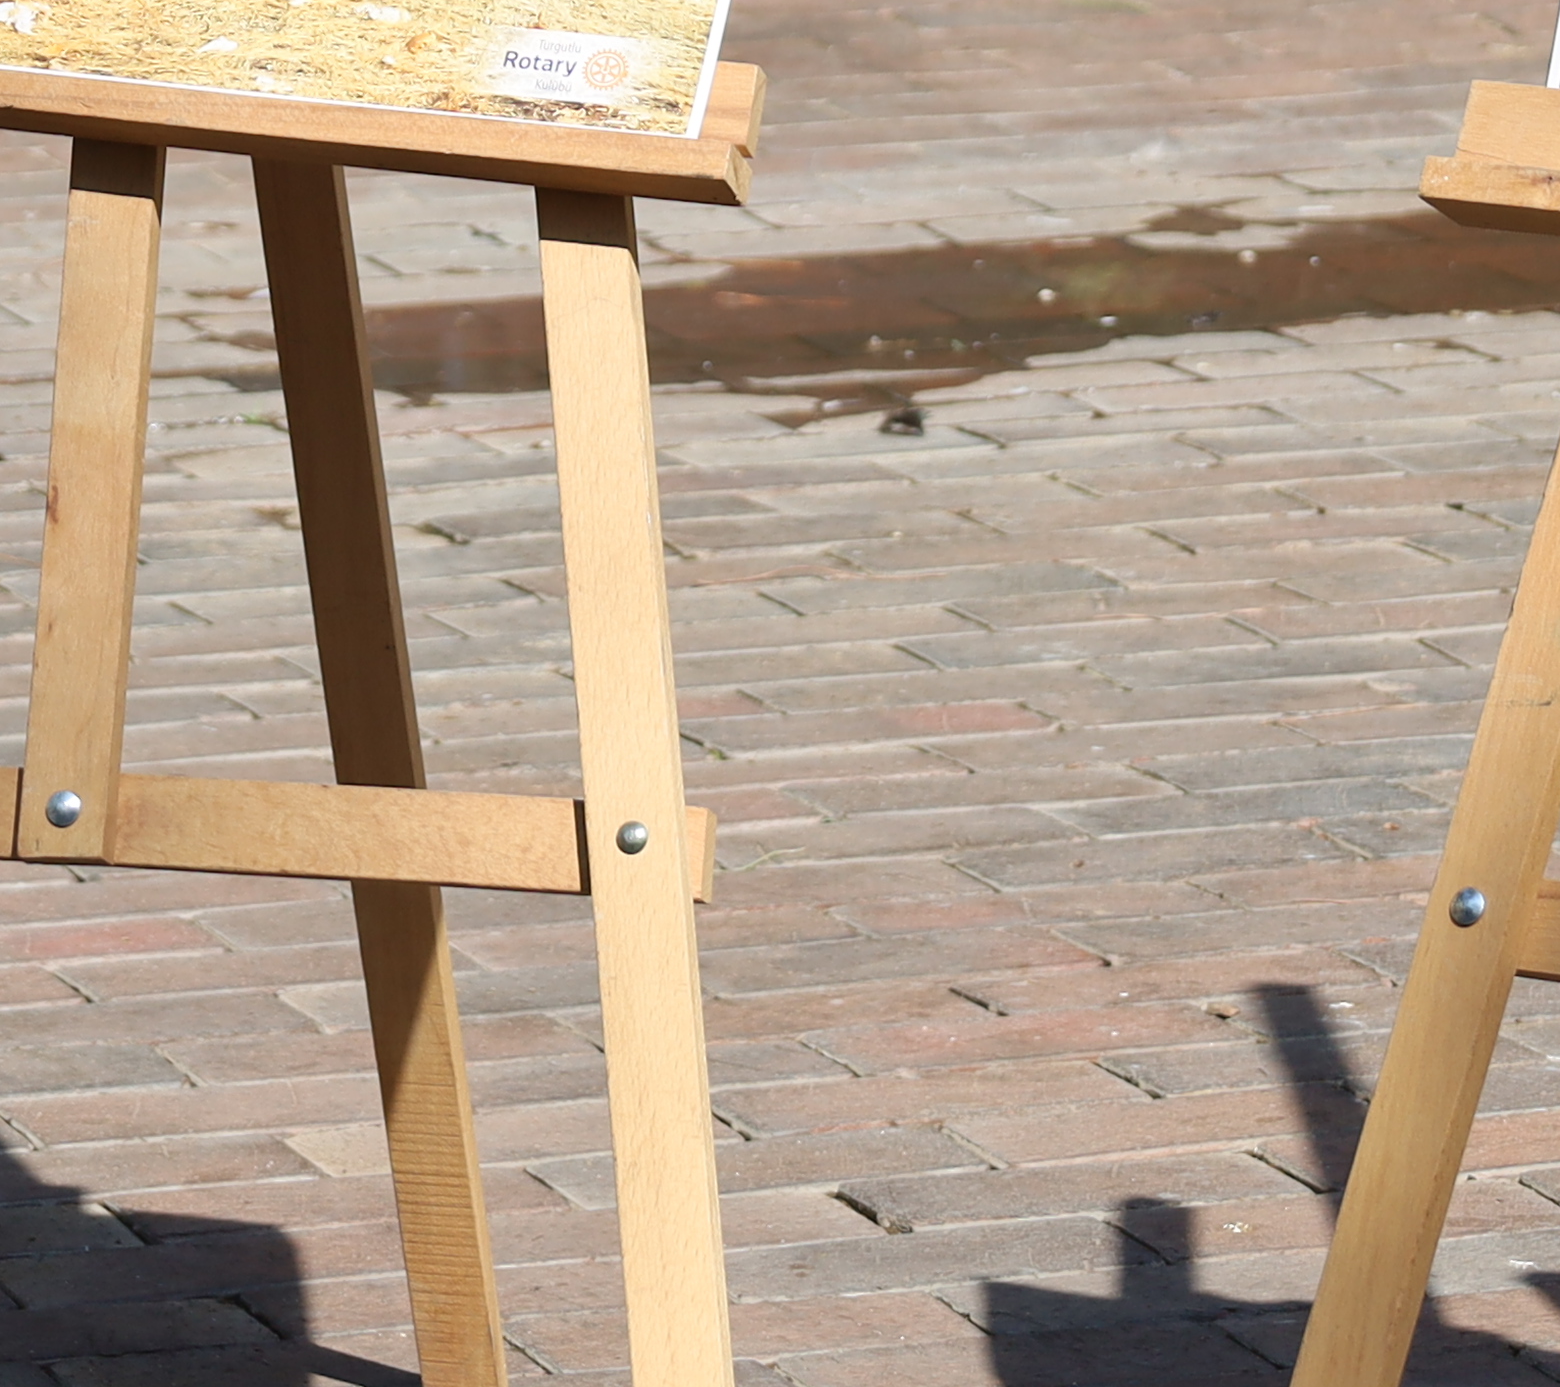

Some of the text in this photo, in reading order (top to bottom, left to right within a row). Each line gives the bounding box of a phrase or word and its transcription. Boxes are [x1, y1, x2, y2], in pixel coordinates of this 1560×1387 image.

[538, 39, 581, 55] Turgutlu
[502, 50, 577, 77] Rotary
[534, 79, 572, 93] Kulübü
